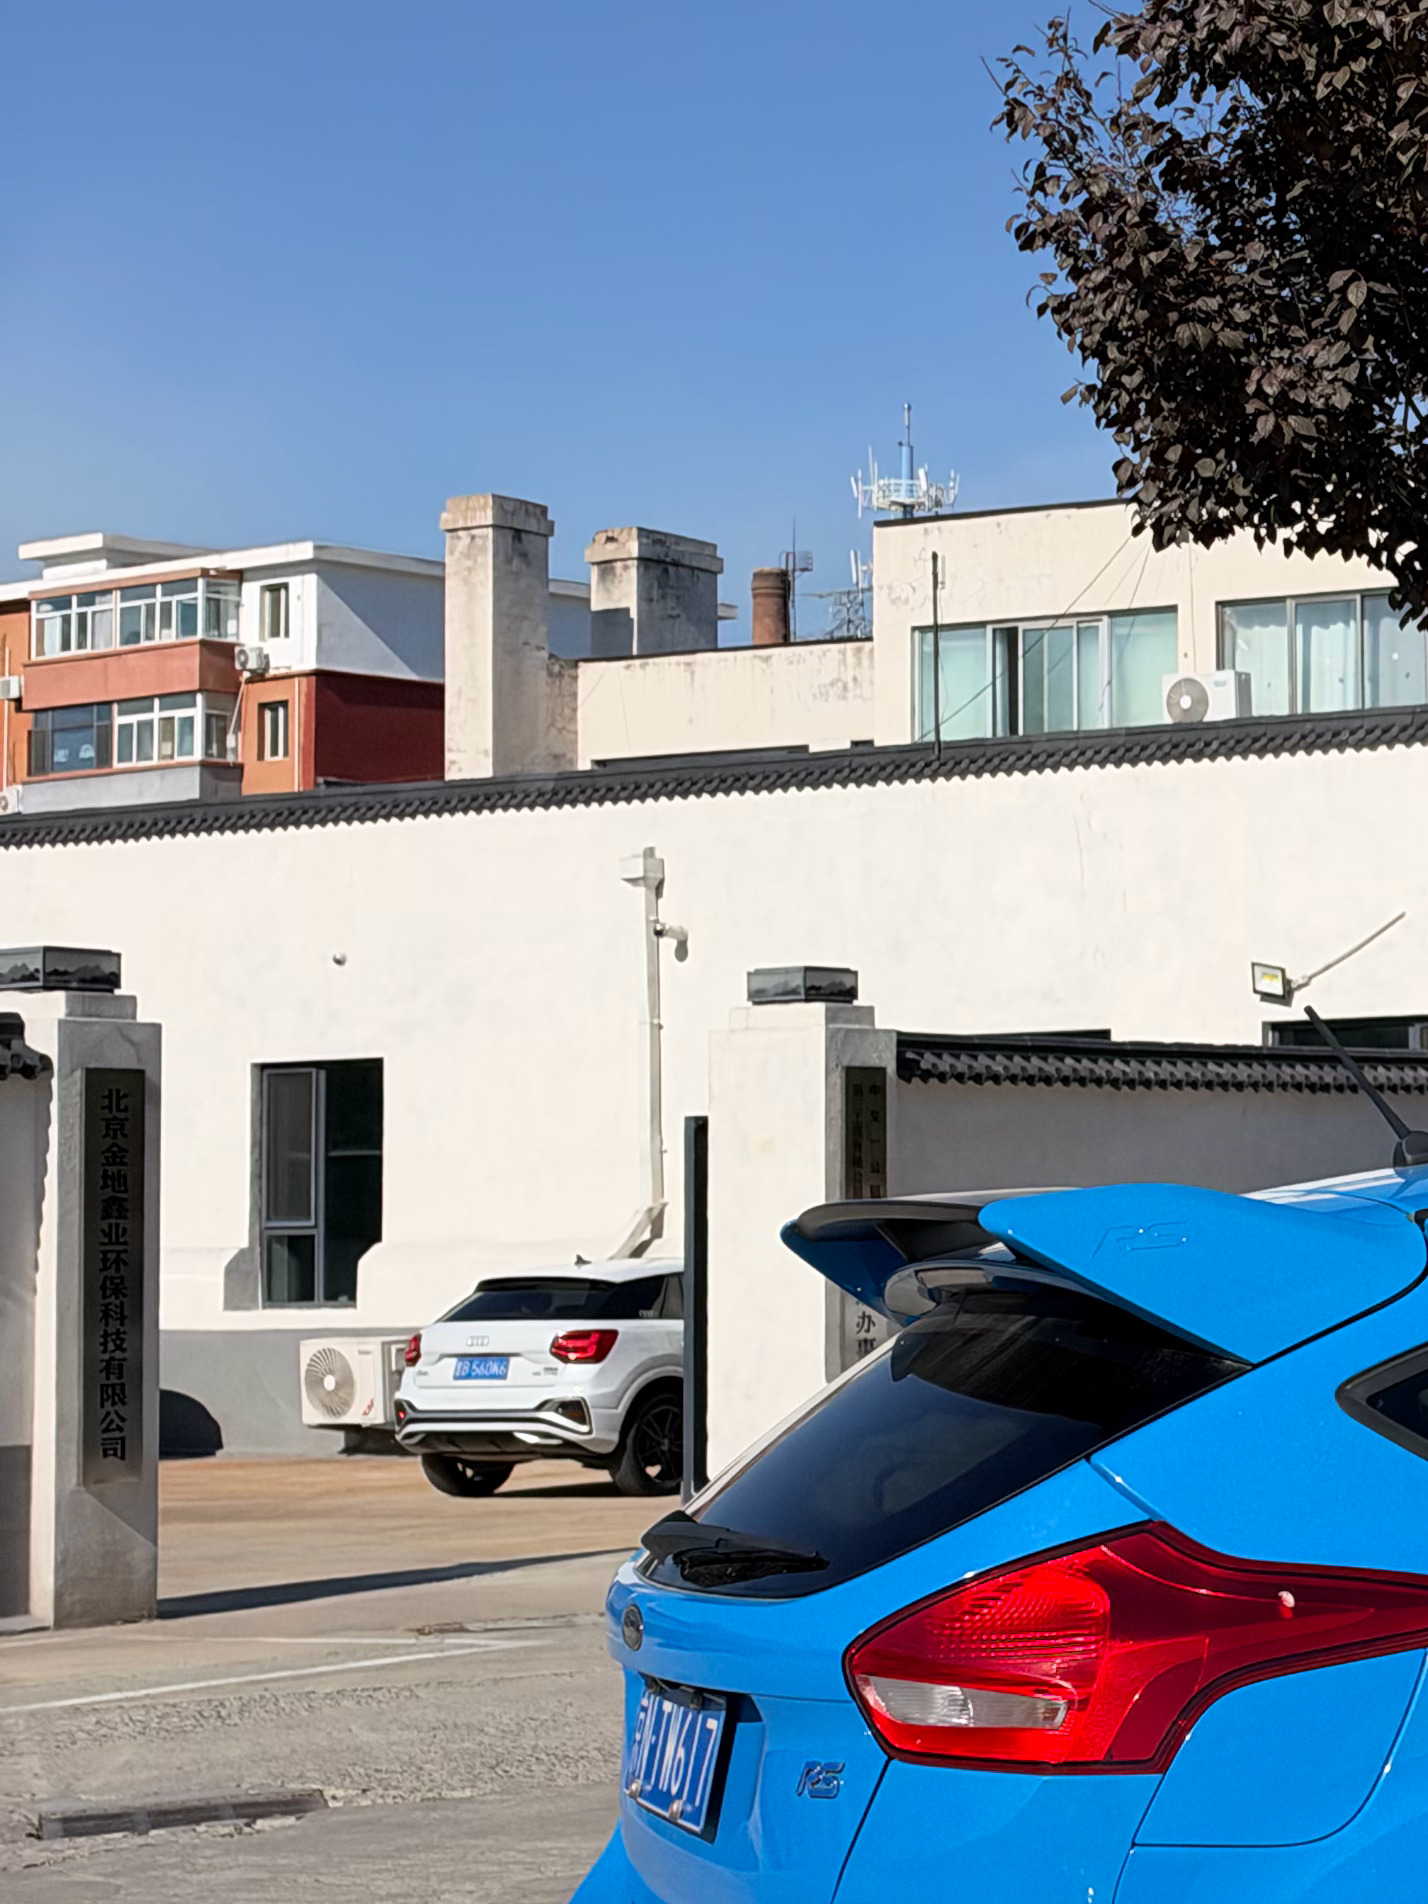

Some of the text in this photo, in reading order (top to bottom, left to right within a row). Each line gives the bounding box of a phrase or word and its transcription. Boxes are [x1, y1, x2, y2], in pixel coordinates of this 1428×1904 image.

[99, 1088, 130, 1461] 北京金地鑫业环保科技有限公司
